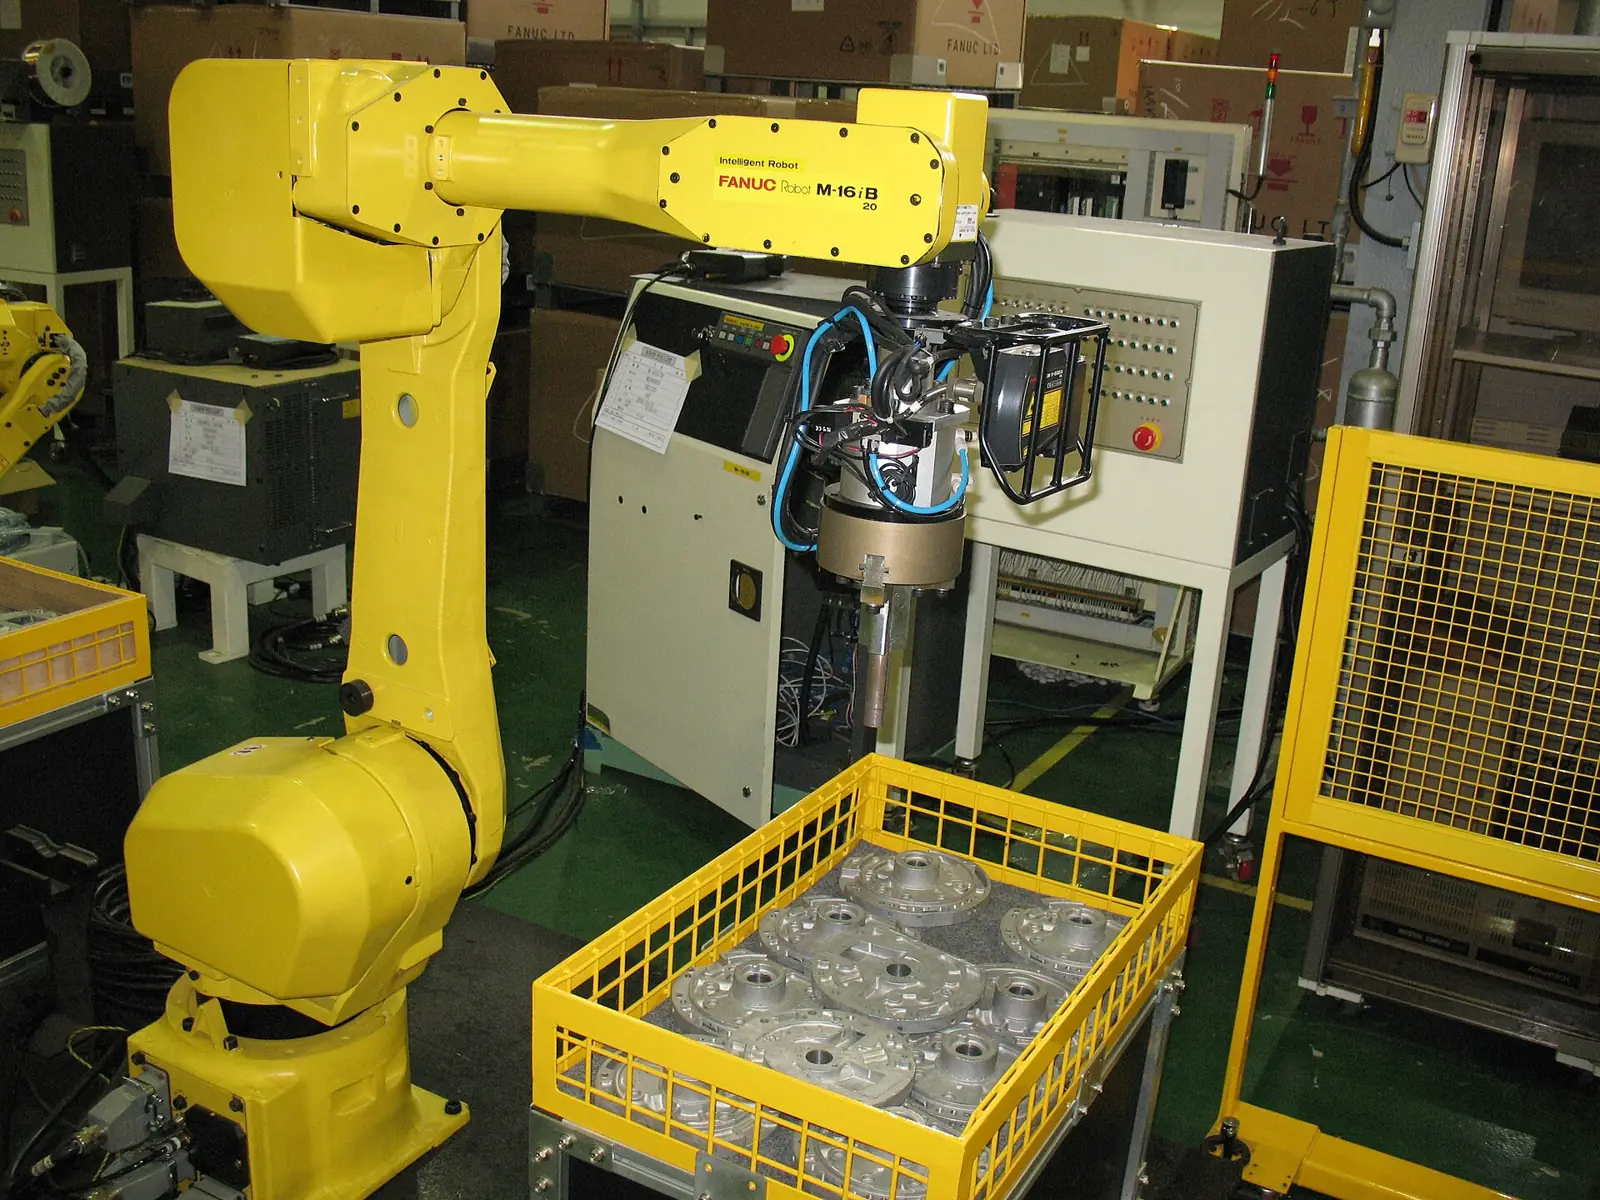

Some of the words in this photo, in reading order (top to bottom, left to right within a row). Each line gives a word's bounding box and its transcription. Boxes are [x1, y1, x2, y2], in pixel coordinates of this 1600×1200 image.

[507, 25, 547, 40] FANUC
[947, 38, 979, 55] FANUC
[719, 156, 765, 167] Intelligent
[768, 159, 799, 170] Robot
[718, 175, 777, 192] FANUC
[780, 180, 812, 195] Robot
[862, 202, 878, 211] 20
